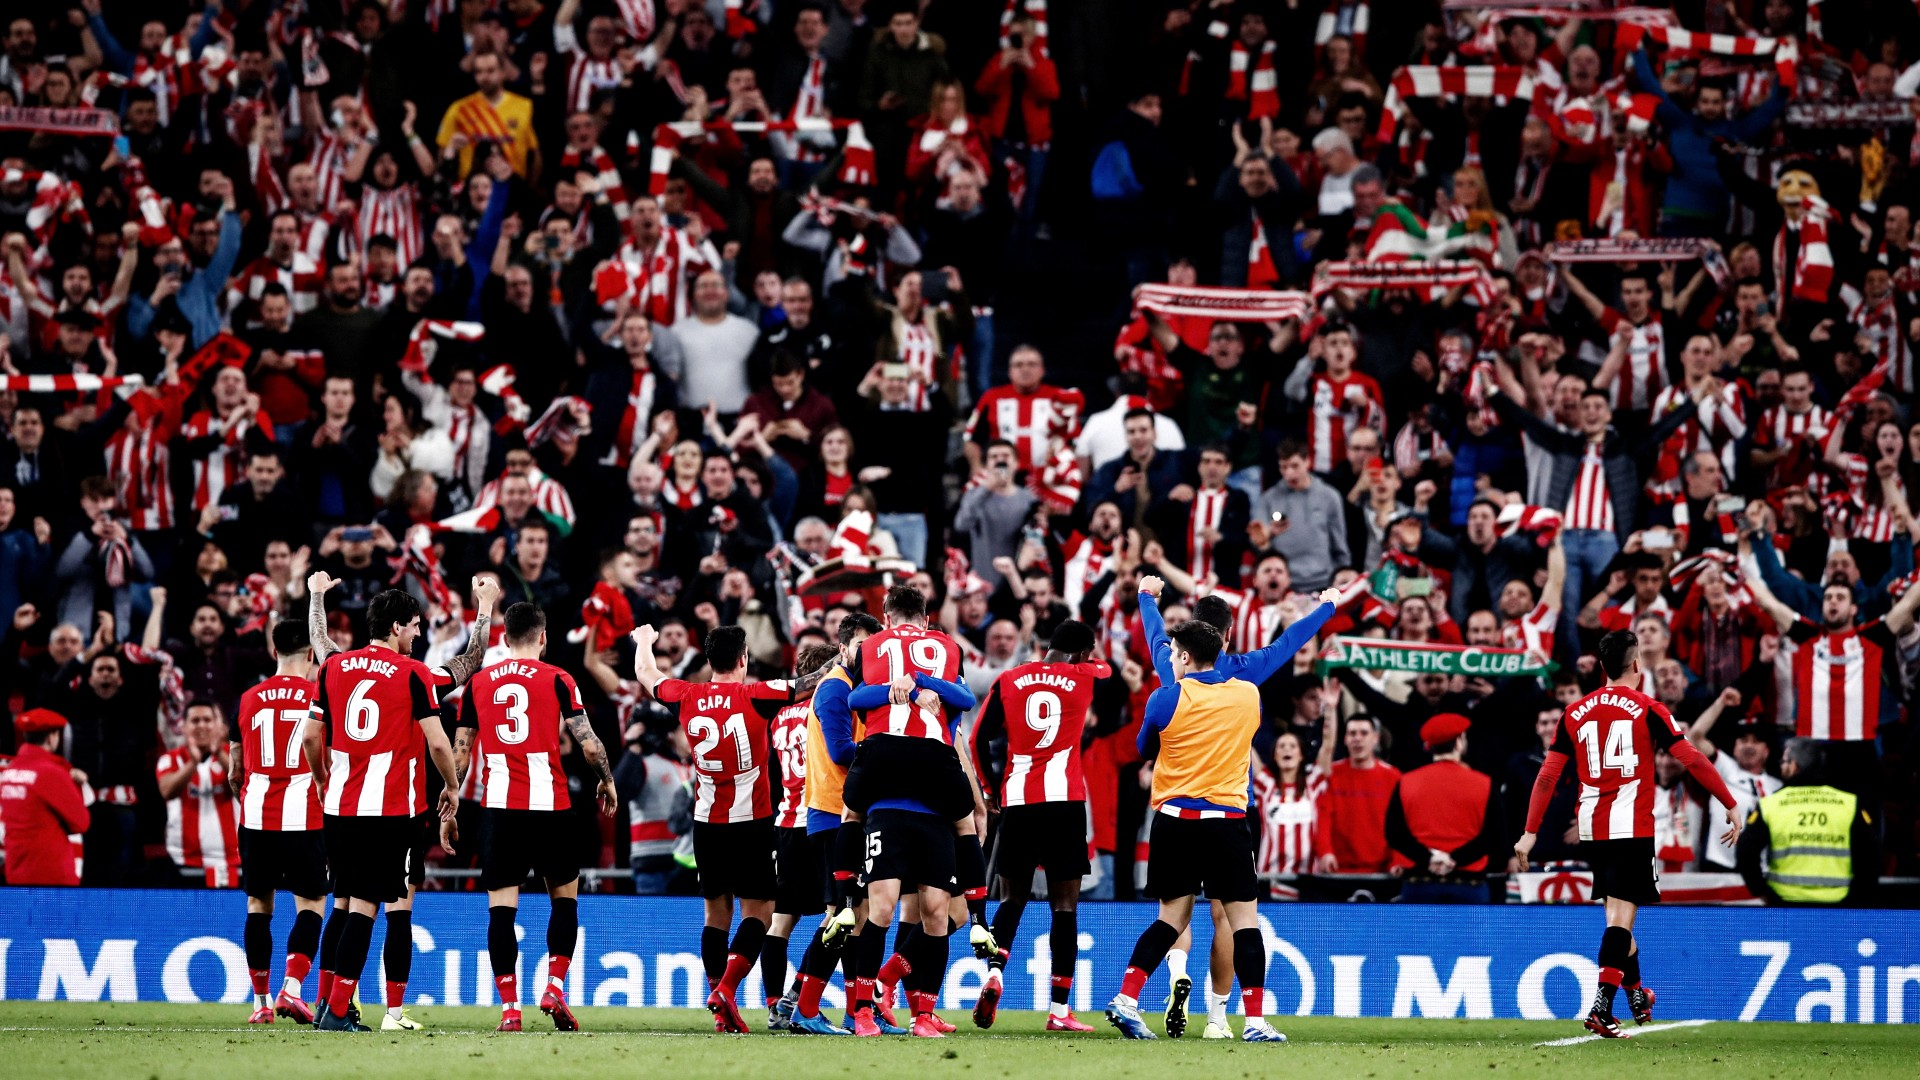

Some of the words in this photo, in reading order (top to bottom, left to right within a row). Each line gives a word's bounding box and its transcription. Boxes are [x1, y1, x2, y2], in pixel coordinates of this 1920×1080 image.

[341, 657, 368, 673] SAN
[367, 660, 398, 678] JOSE
[489, 661, 538, 682] NUÑEZ
[877, 638, 947, 685] 19
[1349, 643, 1452, 671] ATHLETIC
[1460, 648, 1521, 673] CLUB
[257, 688, 293, 703] YURI
[293, 689, 307, 703] B.
[1013, 673, 1076, 692] WILLIAMS
[344, 679, 380, 742] 6
[493, 683, 530, 745] 3
[697, 695, 731, 711] CAPA
[1025, 691, 1062, 748] 9
[1570, 695, 1598, 721] DANI
[1600, 693, 1643, 720] GARCIA
[252, 708, 310, 768] 17
[687, 713, 752, 772] 21
[772, 723, 807, 780] 10
[1577, 720, 1639, 778] 14
[1798, 812, 1828, 826] 270
